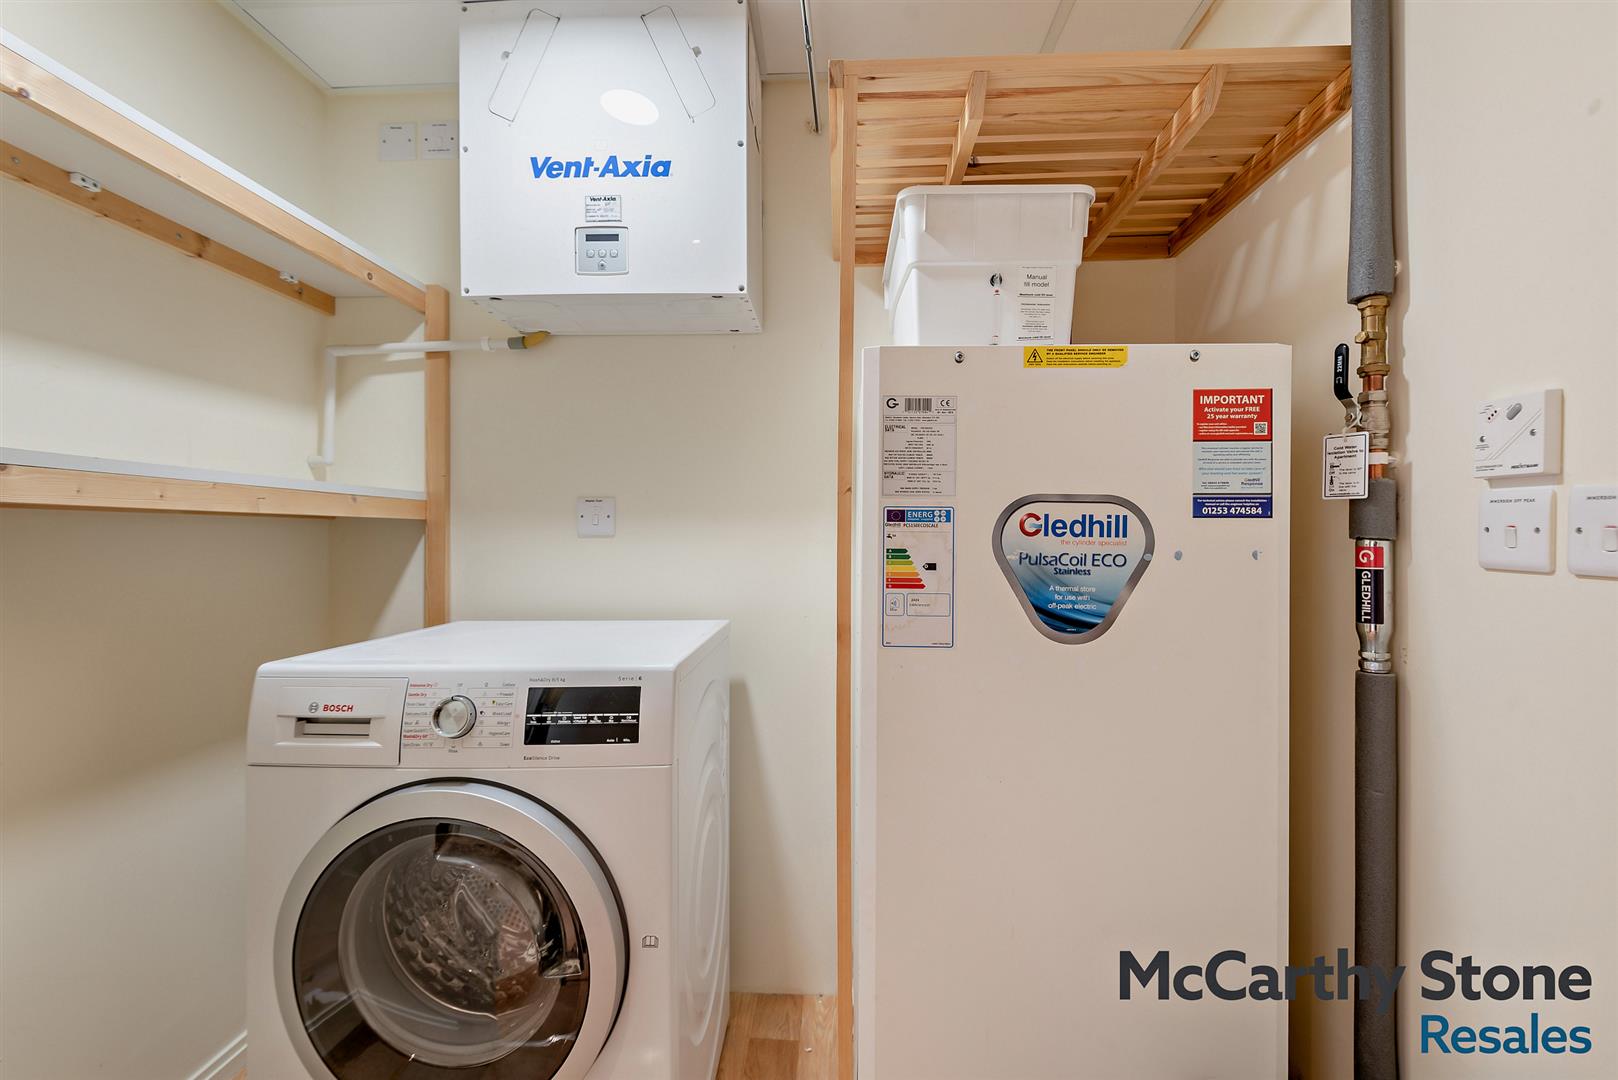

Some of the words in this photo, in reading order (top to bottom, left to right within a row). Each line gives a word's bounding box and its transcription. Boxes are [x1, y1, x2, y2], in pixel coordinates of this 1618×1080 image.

[530, 155, 672, 179] Vent-Axia
[1199, 394, 1265, 405] IMPORTANT
[1019, 512, 1128, 538] Gledhill
[1072, 539, 1096, 547] cylinder
[1019, 552, 1087, 567] PulsaCoil
[1092, 553, 1127, 568] ECO
[1359, 550, 1374, 564] G
[1054, 567, 1091, 576] Stainless
[1361, 570, 1372, 622] GLEDHILL
[322, 704, 354, 712] BOSCH
